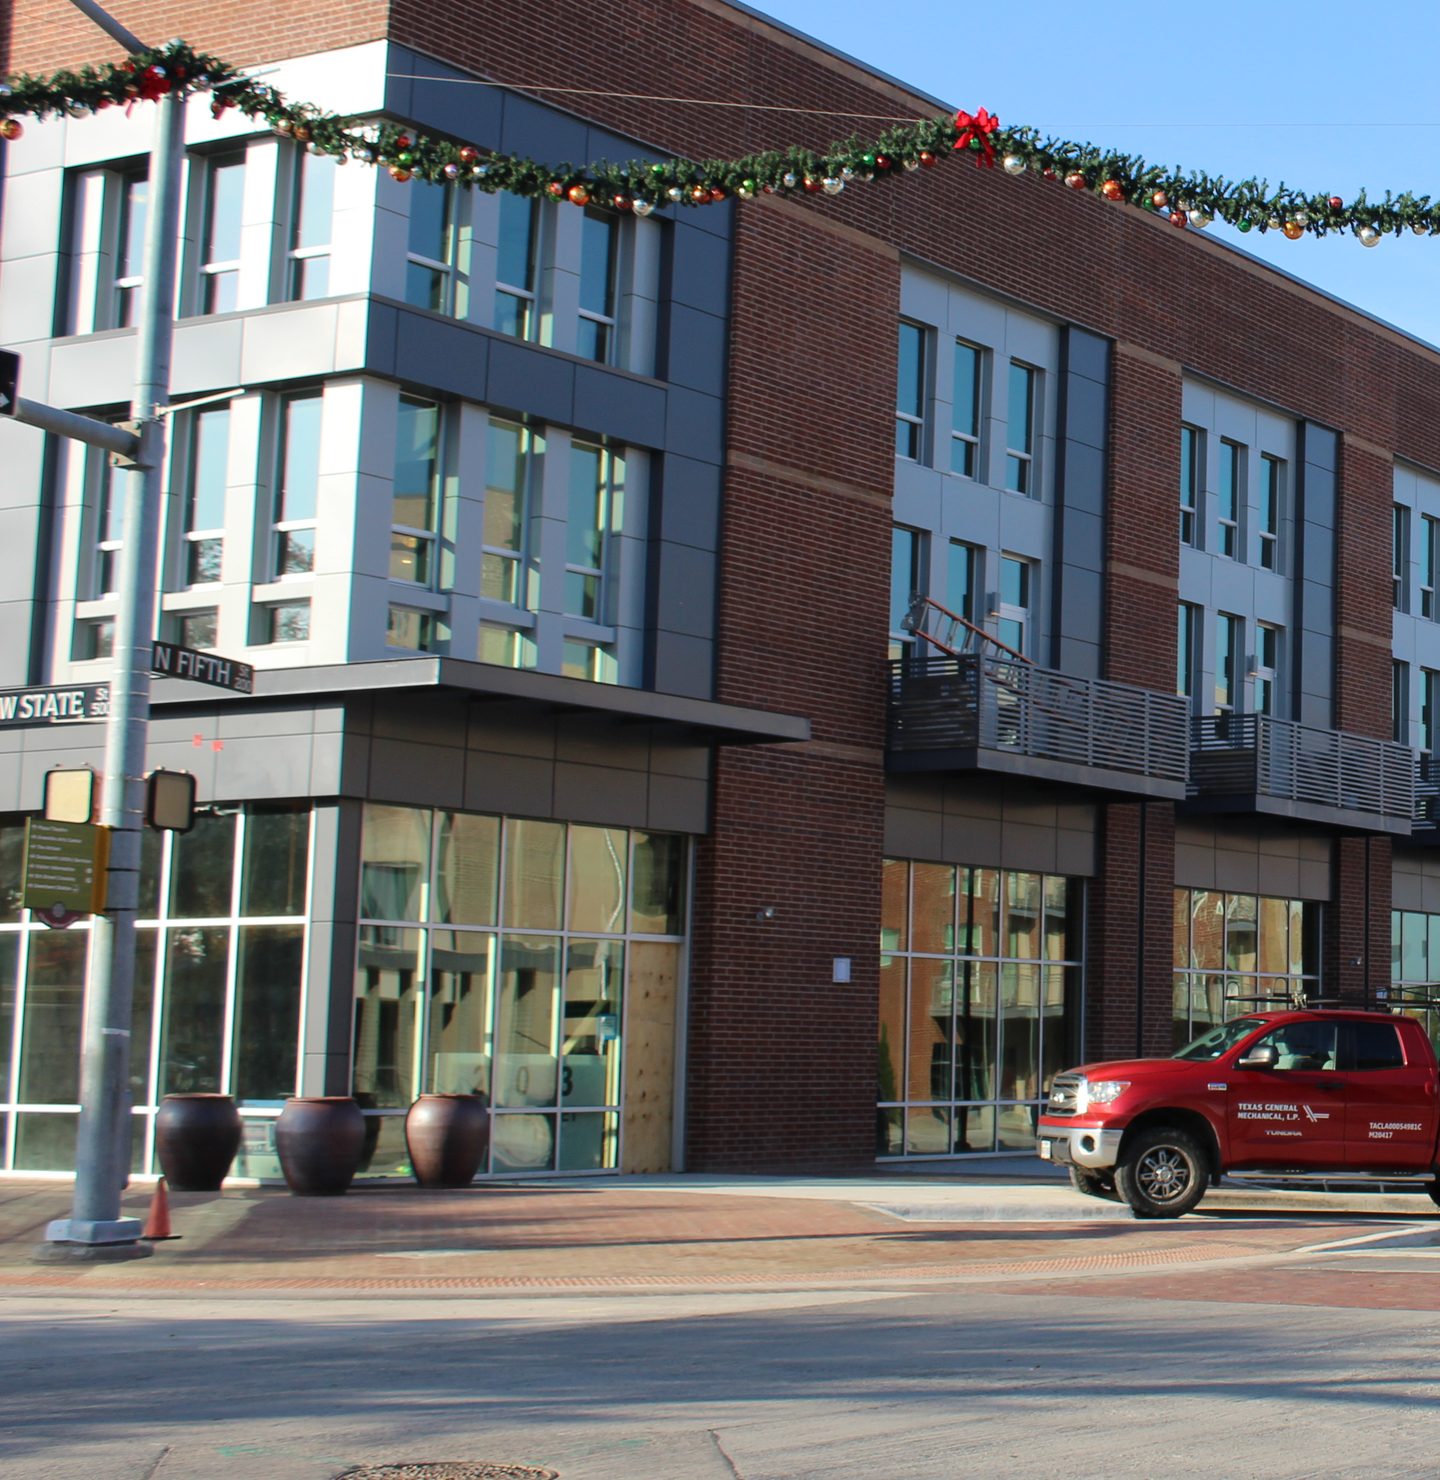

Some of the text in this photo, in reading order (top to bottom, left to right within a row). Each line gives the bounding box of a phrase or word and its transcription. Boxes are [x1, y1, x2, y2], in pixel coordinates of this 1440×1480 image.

[154, 645, 172, 672] N
[176, 650, 231, 685] FIFTH
[0, 695, 18, 720] W
[18, 690, 86, 719] STATE
[1237, 1112, 1301, 1121] MECHANICAL, L.P.
[1238, 1103, 1299, 1112] TEXAS GENERAL
